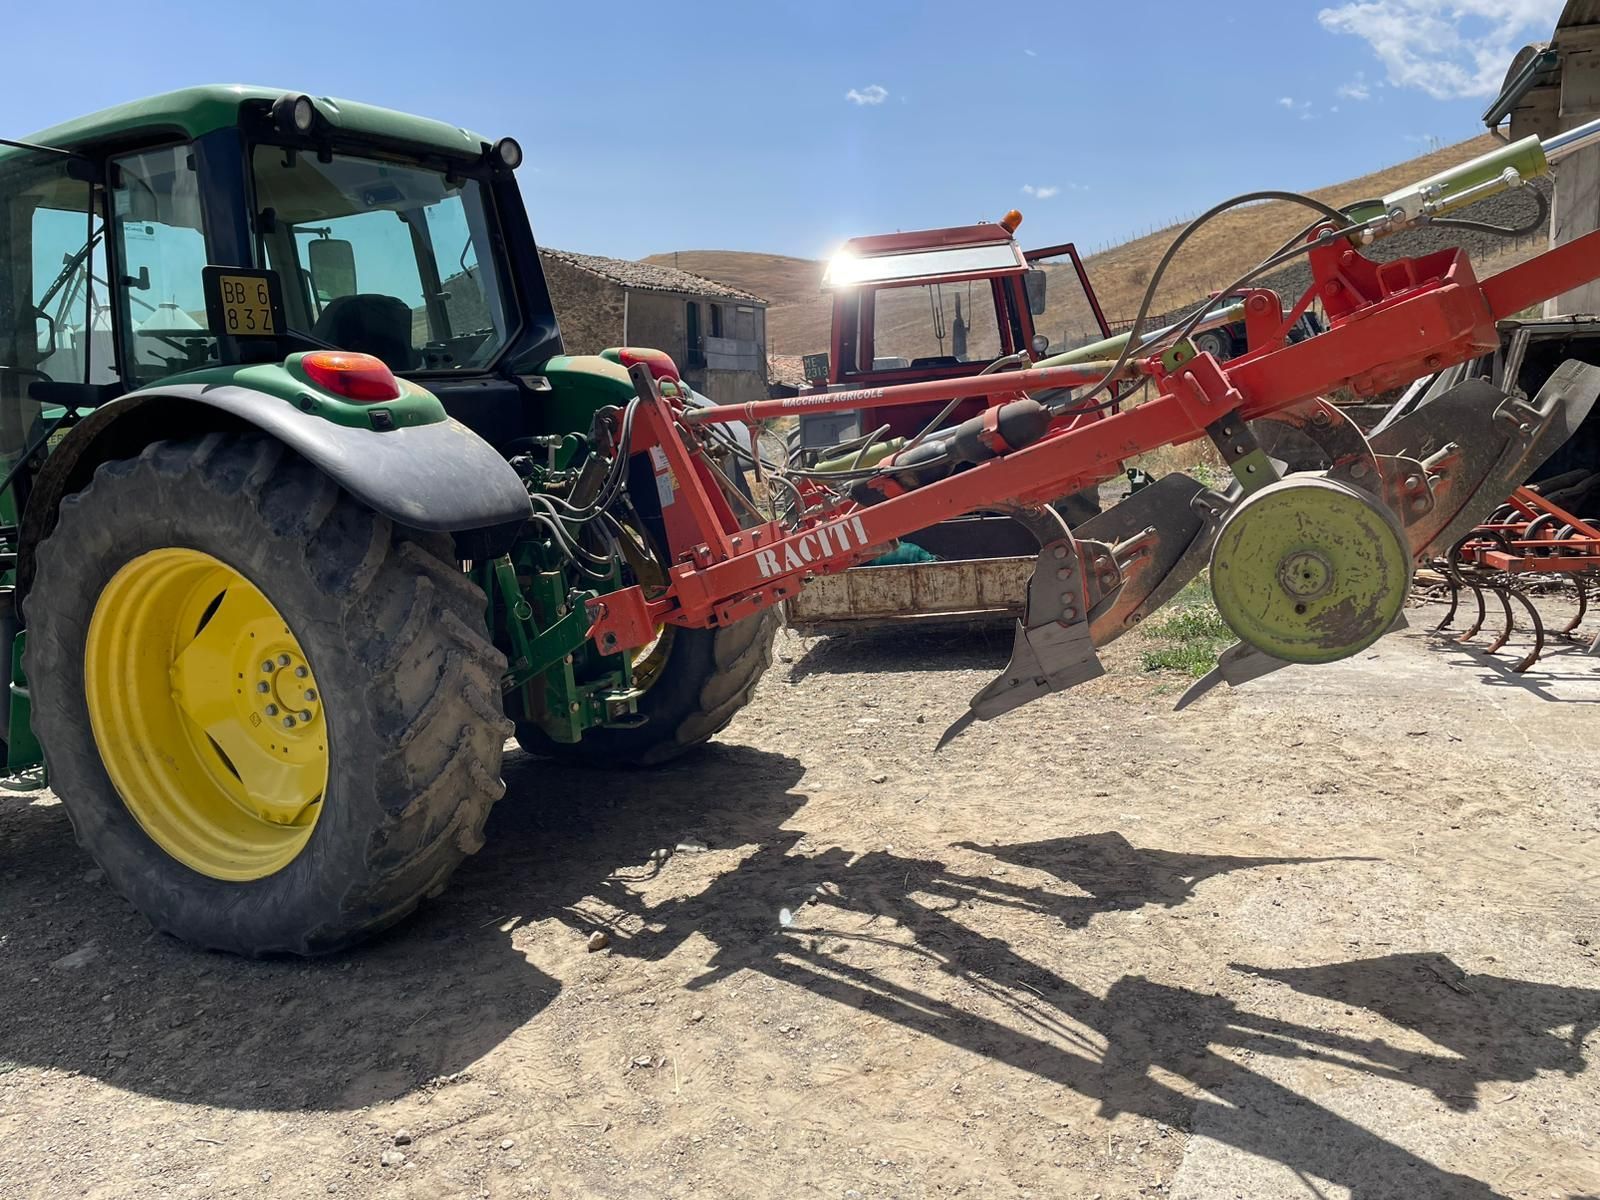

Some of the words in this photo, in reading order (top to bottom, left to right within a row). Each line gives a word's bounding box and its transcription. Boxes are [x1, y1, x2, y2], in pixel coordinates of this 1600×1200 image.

[223, 282, 246, 304] BB
[257, 284, 268, 305] 6
[782, 395, 831, 408] MACCHINE
[833, 389, 883, 402] AGRICOLE
[755, 516, 869, 578] RACITI
